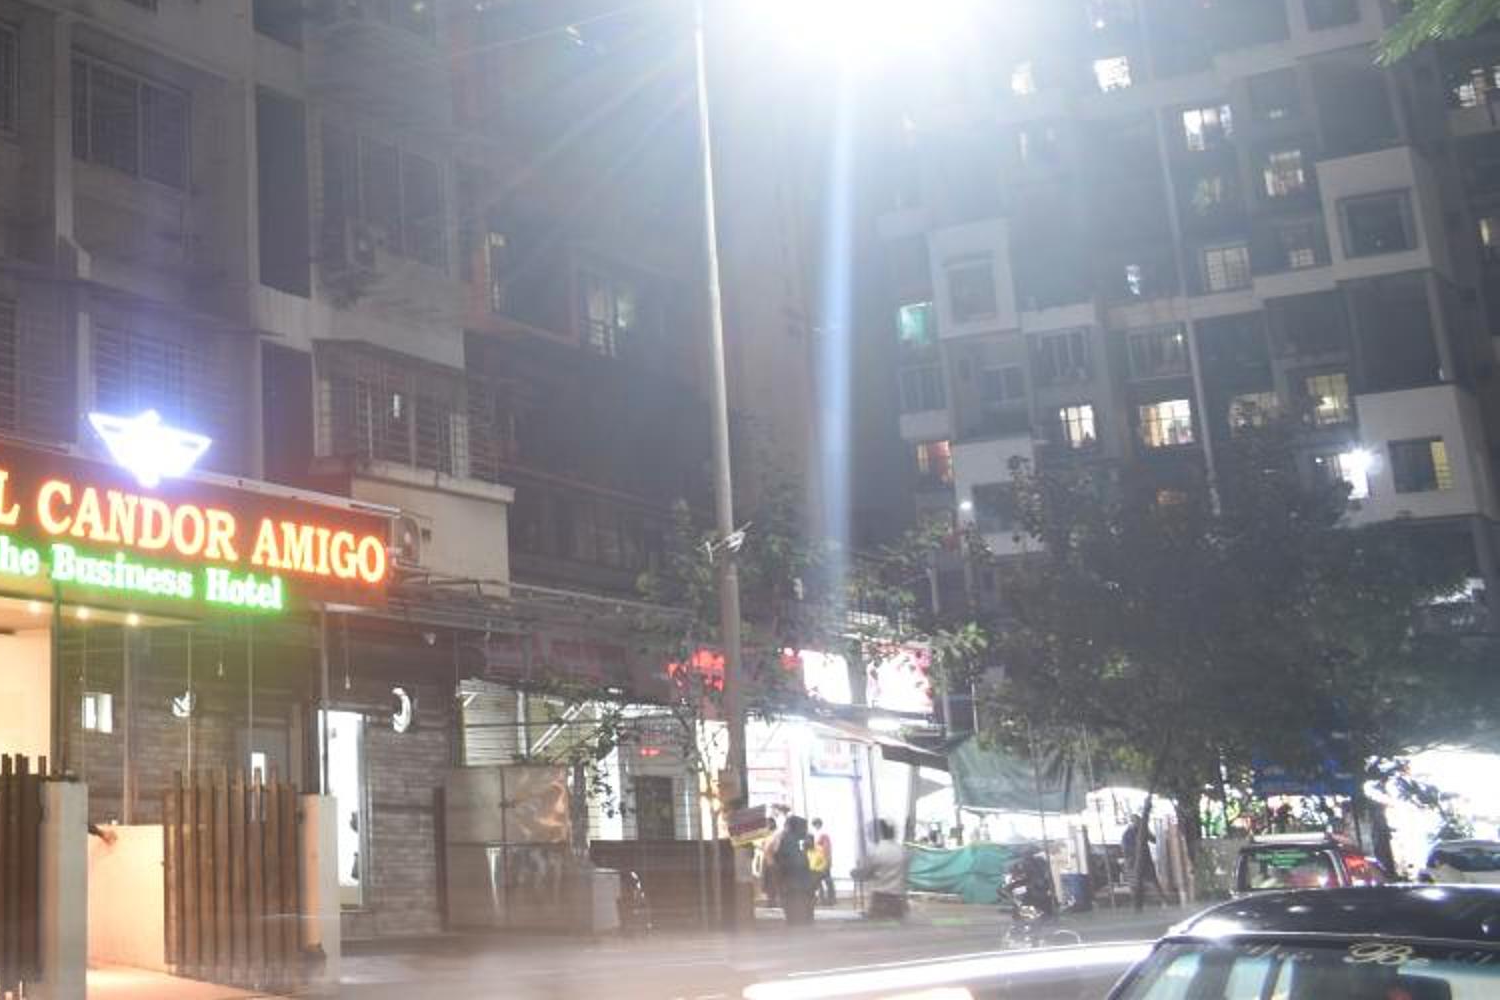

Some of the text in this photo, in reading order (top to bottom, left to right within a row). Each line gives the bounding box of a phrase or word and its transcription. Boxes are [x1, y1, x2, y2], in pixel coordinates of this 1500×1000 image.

[37, 480, 238, 561] CANDOR
[252, 517, 388, 583] AMIGO
[52, 543, 192, 598] Business
[205, 567, 283, 610] Hotel
